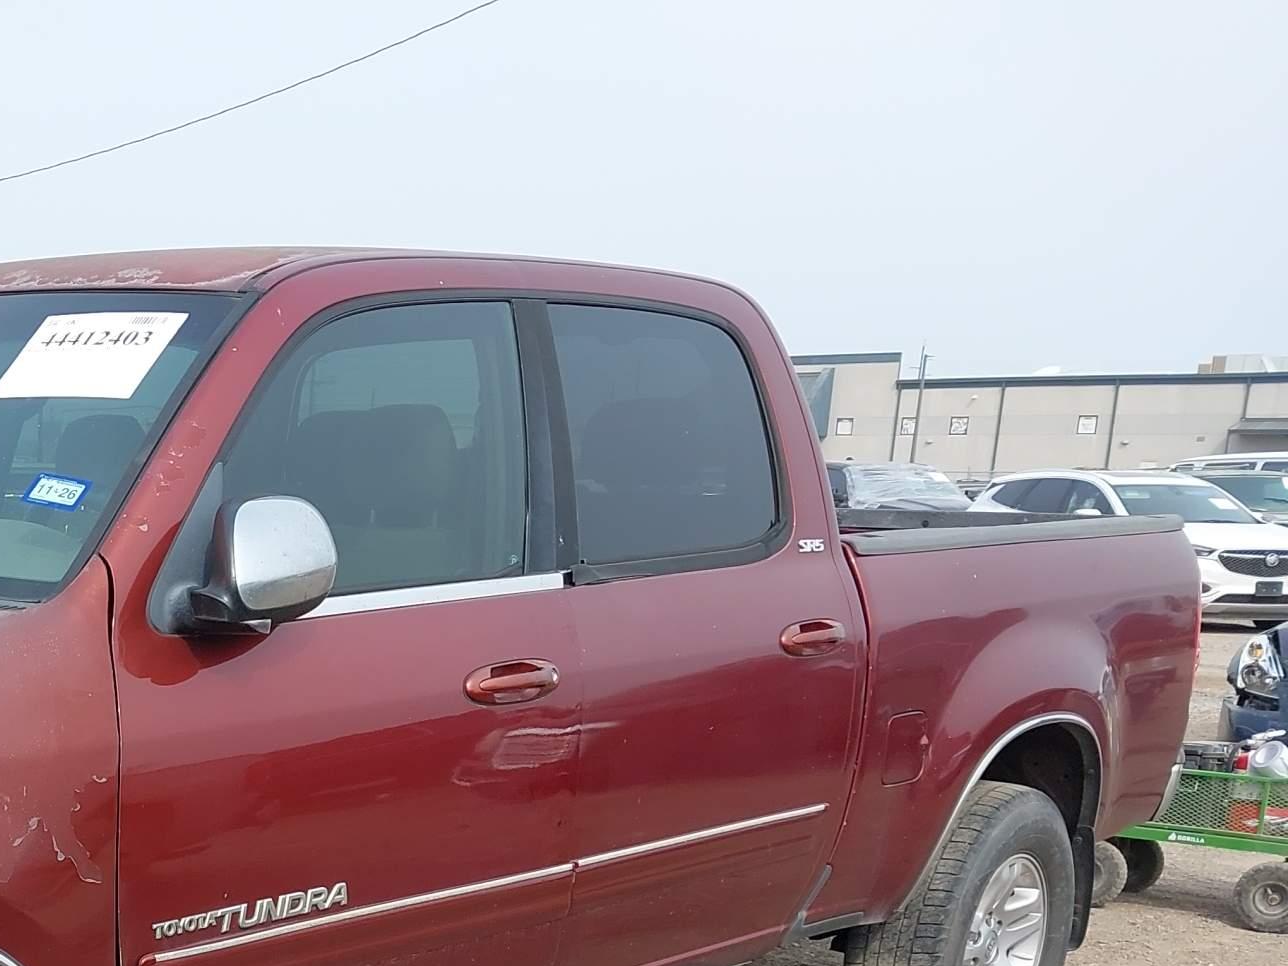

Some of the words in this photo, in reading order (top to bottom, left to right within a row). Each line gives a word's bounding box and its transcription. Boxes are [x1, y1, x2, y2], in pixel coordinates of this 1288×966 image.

[41, 330, 153, 347] 44412403
[58, 488, 78, 500] 26
[798, 539, 824, 552] SR5
[1177, 834, 1205, 844] GORILLA
[152, 911, 217, 939] TOYOTA
[217, 882, 348, 933] TUNDRA
